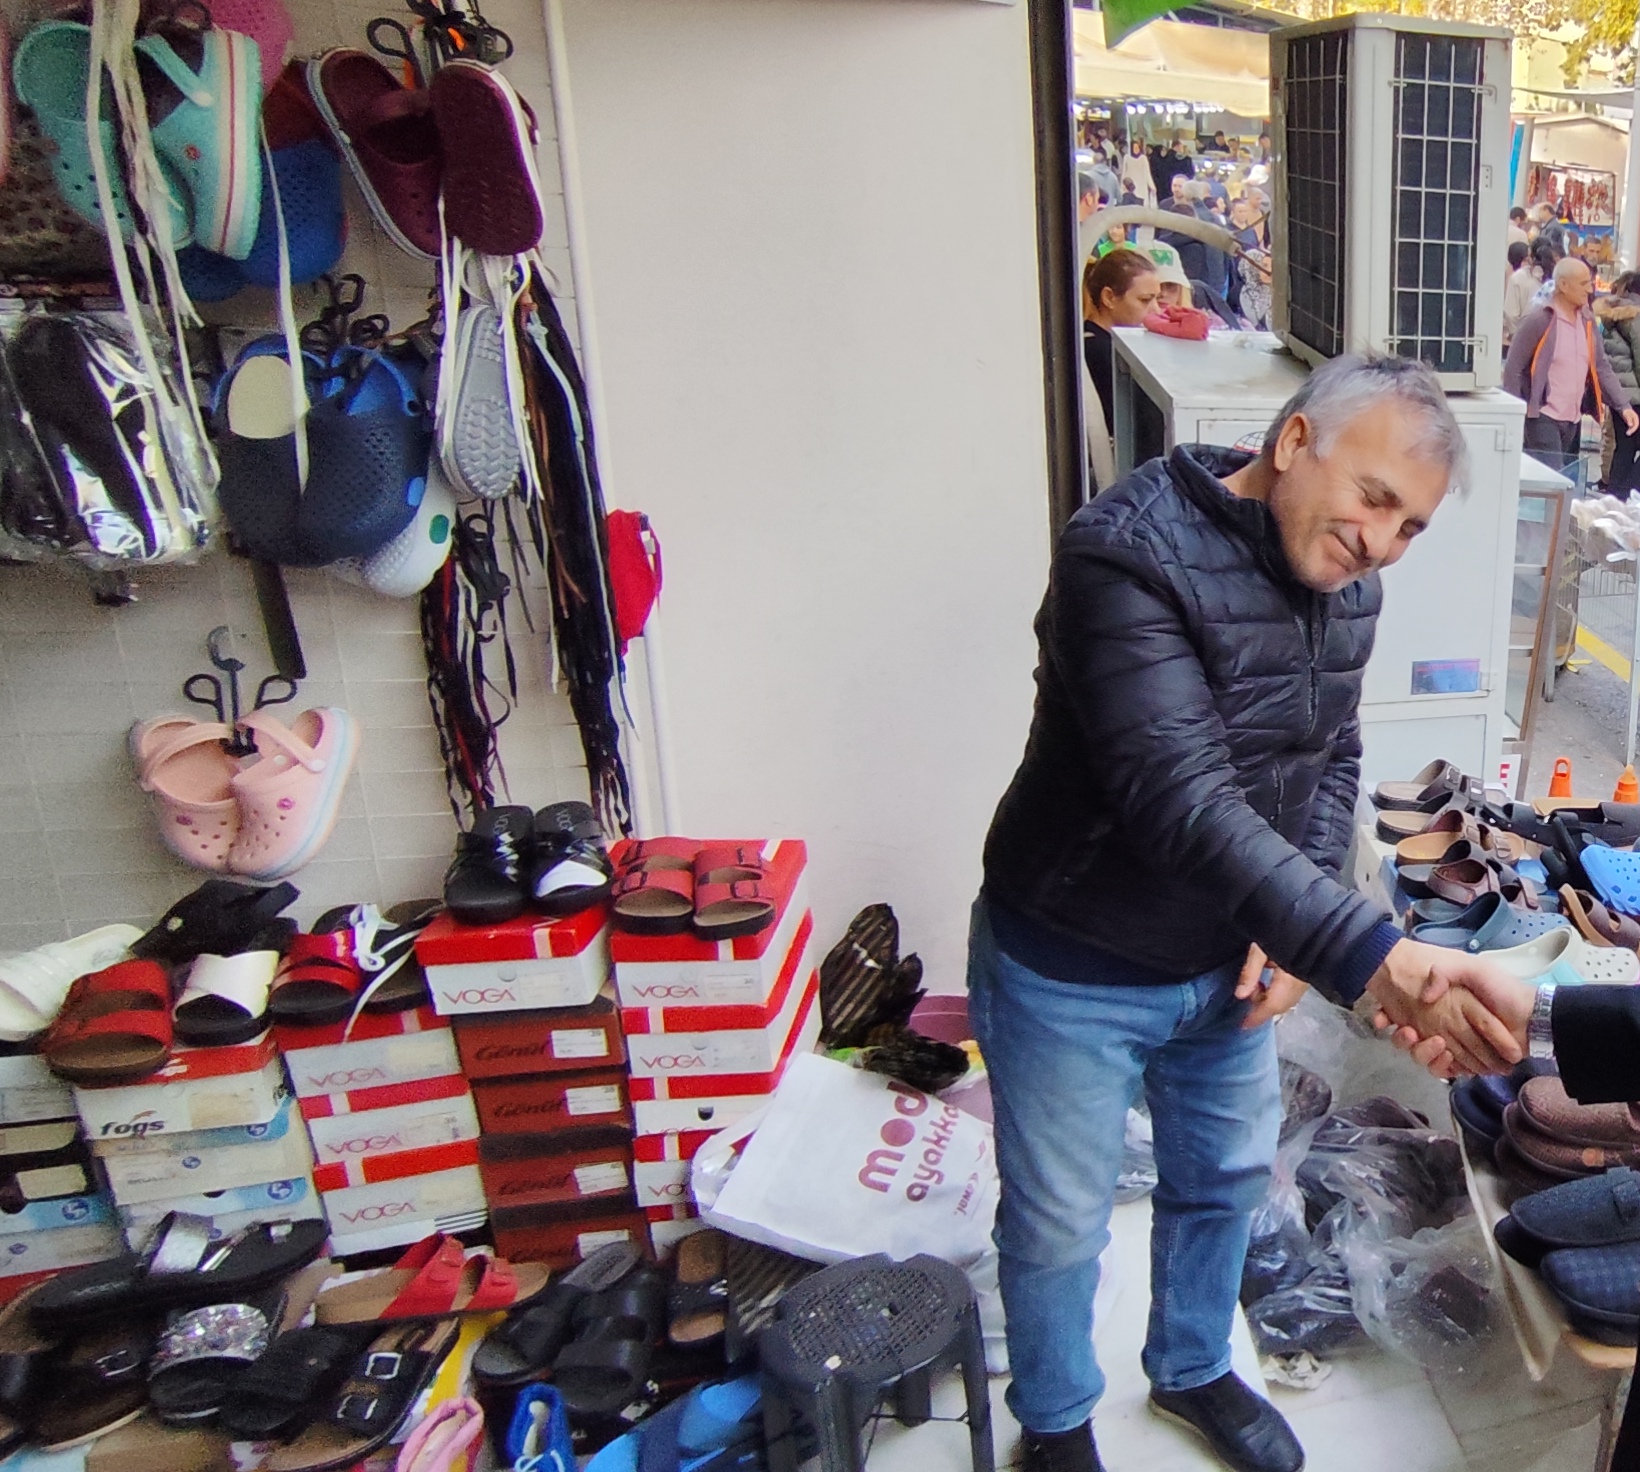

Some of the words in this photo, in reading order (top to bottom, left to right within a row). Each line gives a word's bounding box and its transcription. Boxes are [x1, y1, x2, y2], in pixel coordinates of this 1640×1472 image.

[493, 813, 511, 835] VOG
[556, 808, 573, 831] VOG
[443, 987, 516, 1005] VOGA
[632, 984, 699, 998] VOGA
[639, 1054, 707, 1070] VOGA
[308, 1067, 386, 1088] VOGA
[326, 1132, 402, 1155] VOGA
[648, 1183, 686, 1198] VO
[339, 1201, 417, 1224] VOGA
